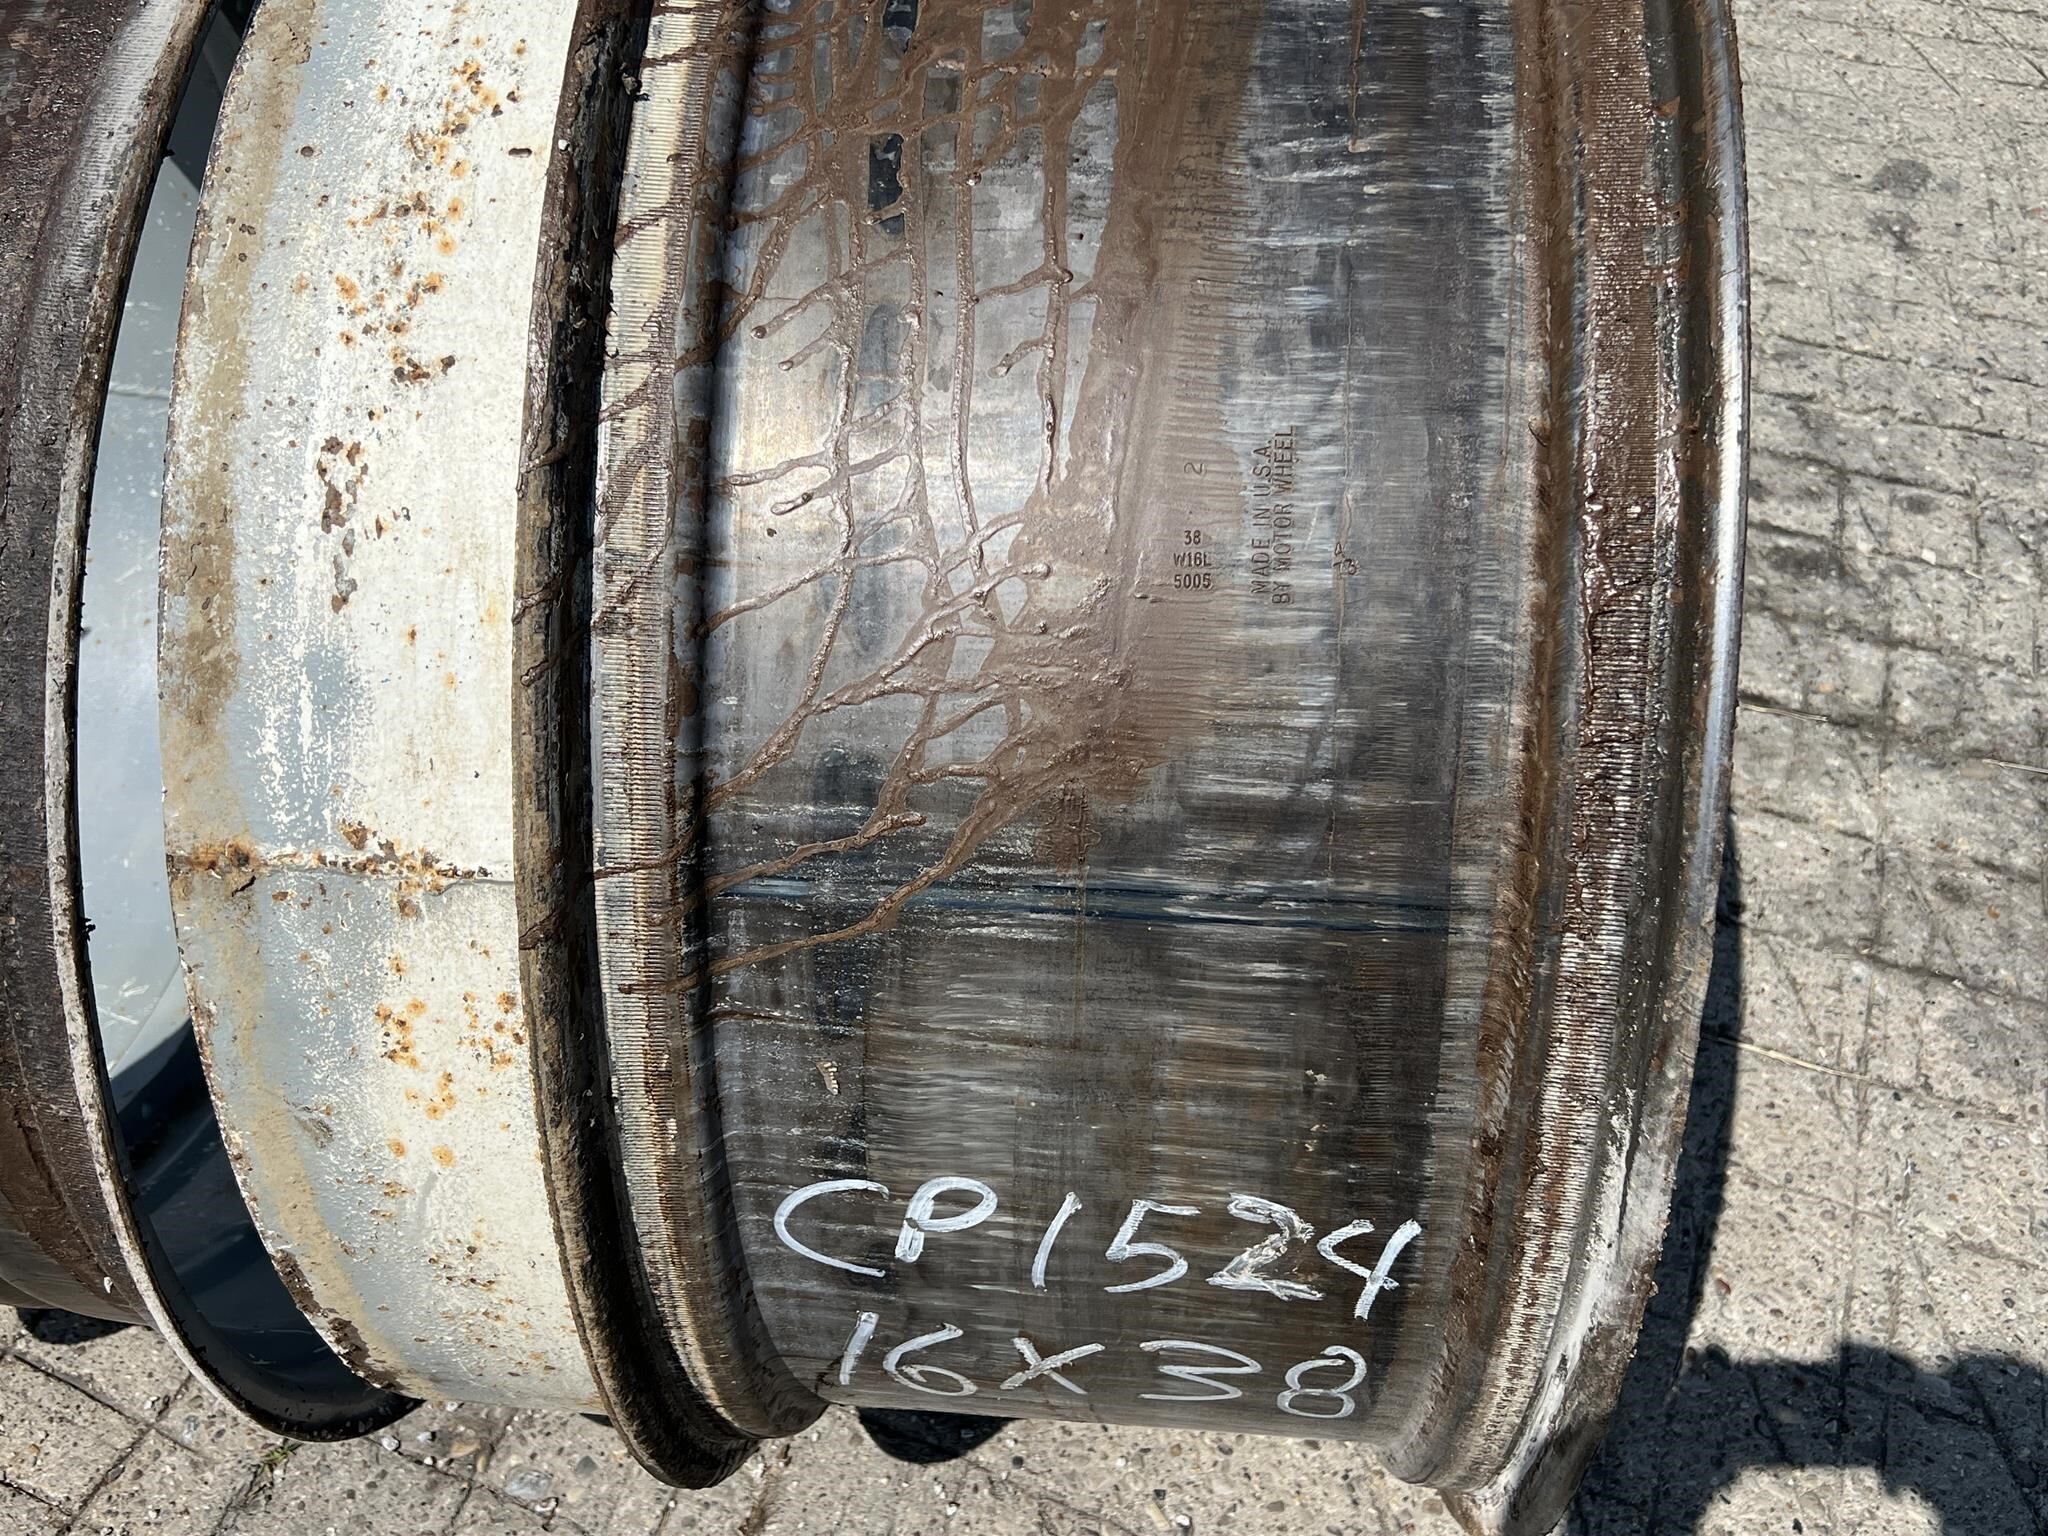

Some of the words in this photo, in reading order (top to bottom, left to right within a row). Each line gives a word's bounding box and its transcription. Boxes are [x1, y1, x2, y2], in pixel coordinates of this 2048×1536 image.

[1253, 440, 1272, 497] U.S.A.
[1274, 426, 1296, 493] WHEEL
[1252, 507, 1271, 526] IN
[1184, 530, 1201, 545] 38
[1273, 503, 1293, 572] MOTOR
[1173, 552, 1212, 567] W16L
[1252, 538, 1271, 594] MADE
[1174, 573, 1212, 589] 5005
[1272, 582, 1292, 604] BY
